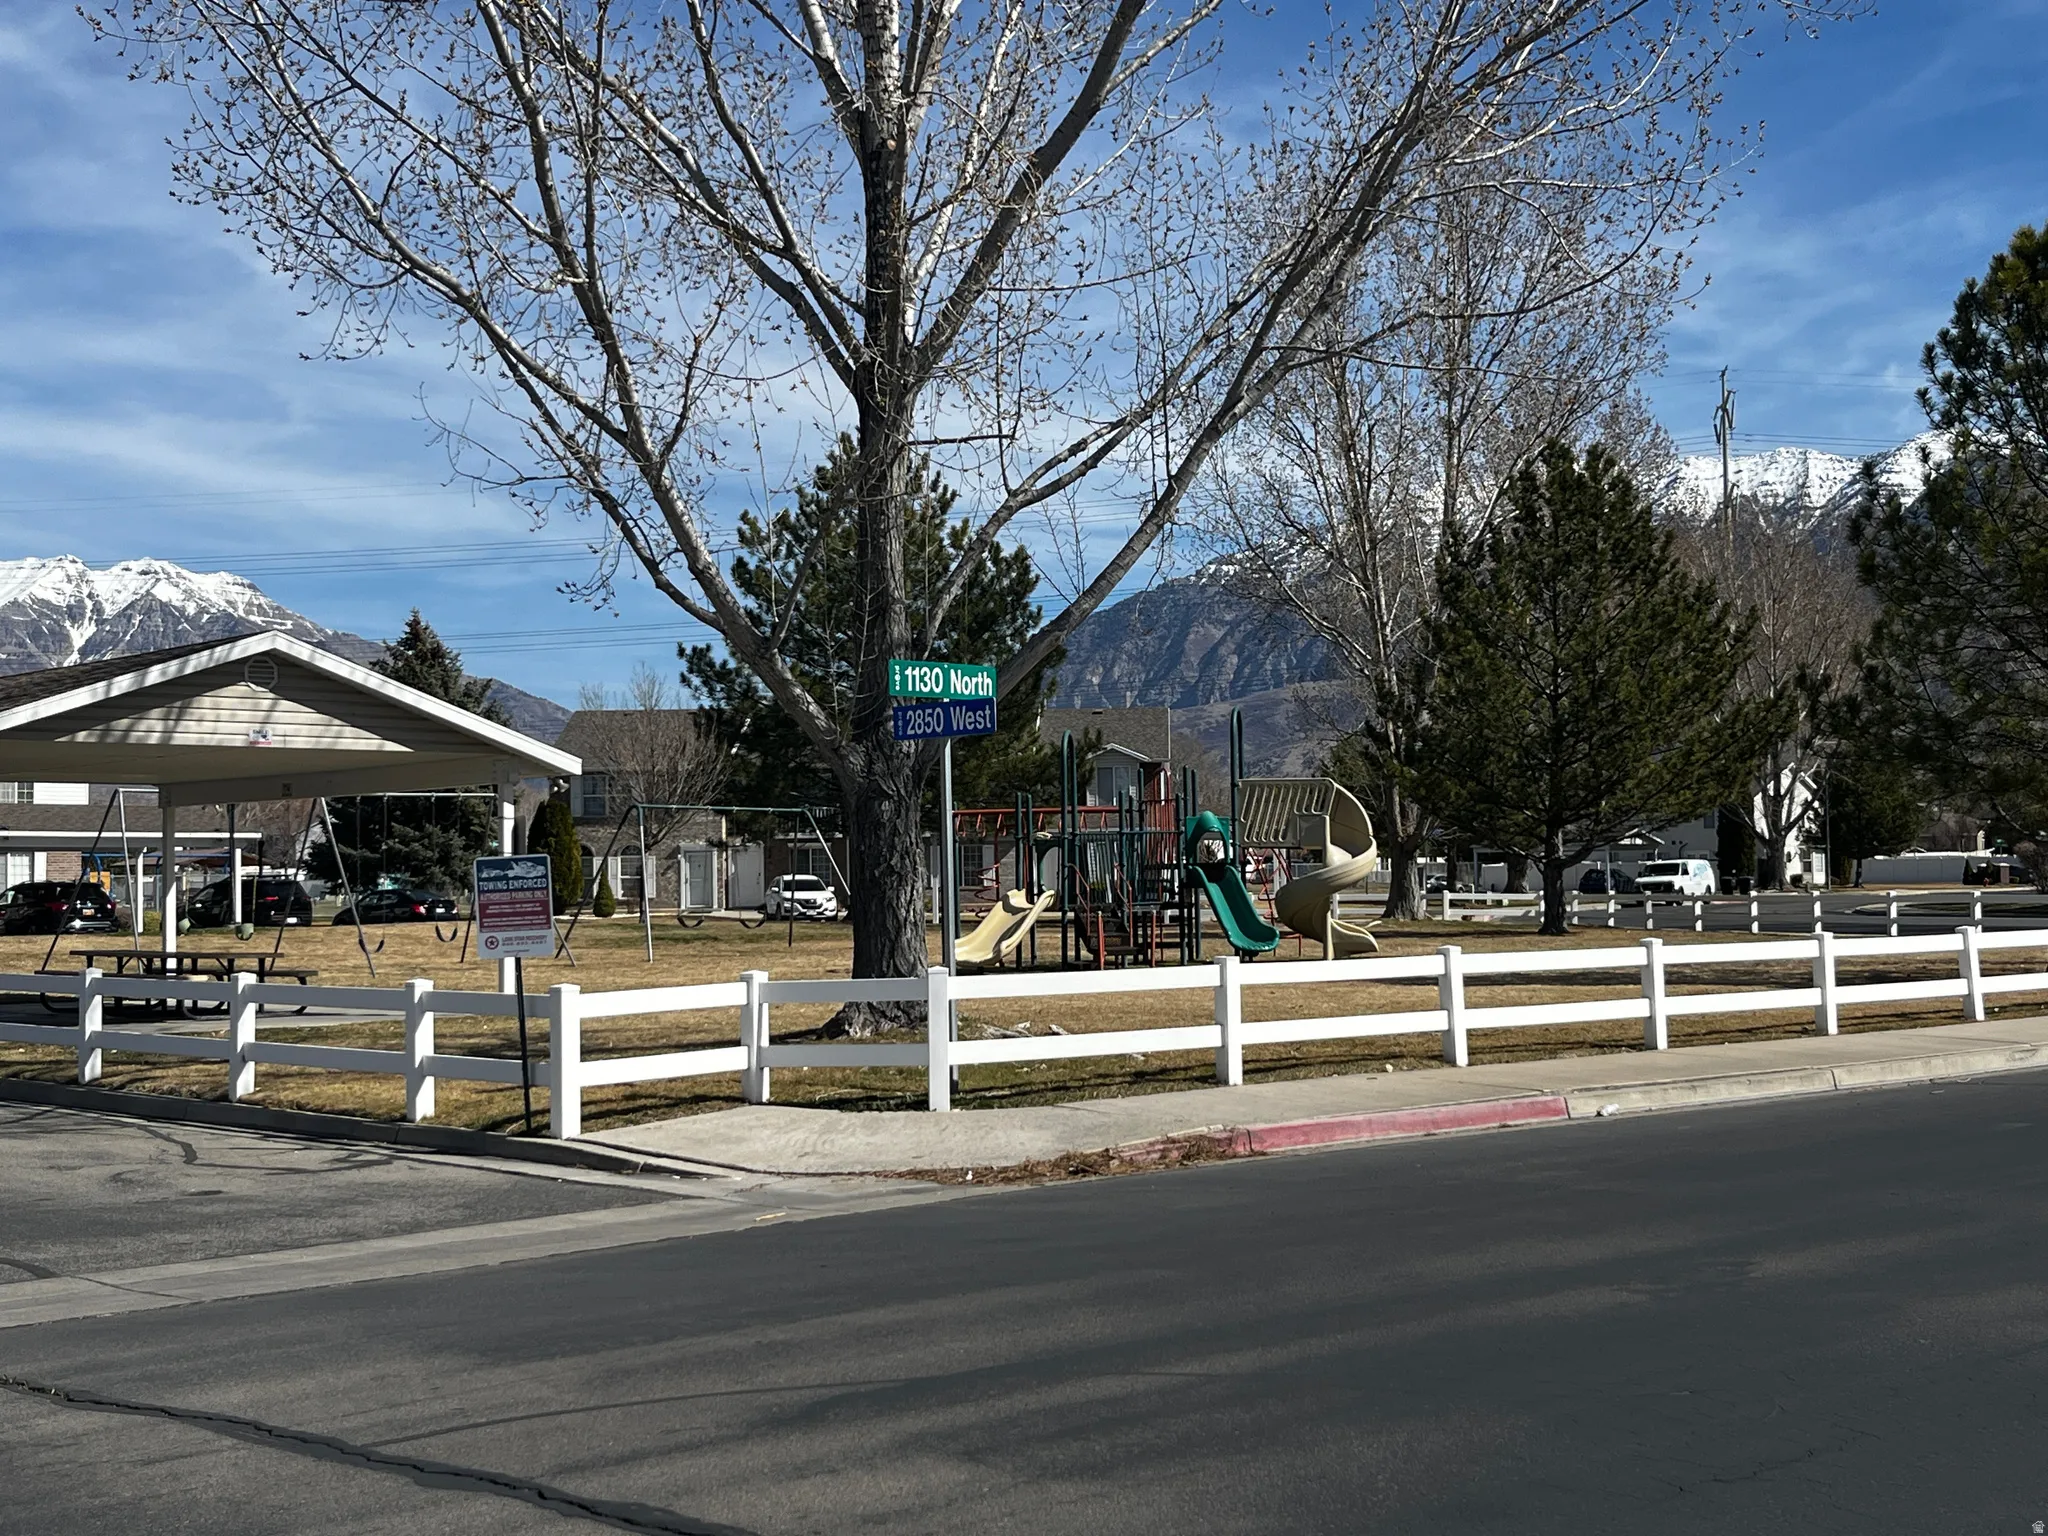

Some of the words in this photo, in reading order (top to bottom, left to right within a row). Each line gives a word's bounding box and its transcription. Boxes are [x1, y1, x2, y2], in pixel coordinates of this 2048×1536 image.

[904, 666, 943, 693] 1130
[950, 669, 993, 696] North
[906, 707, 944, 735] 2850
[950, 705, 991, 731] West
[479, 881, 508, 891] TOWING
[509, 879, 547, 889] ENFORCED
